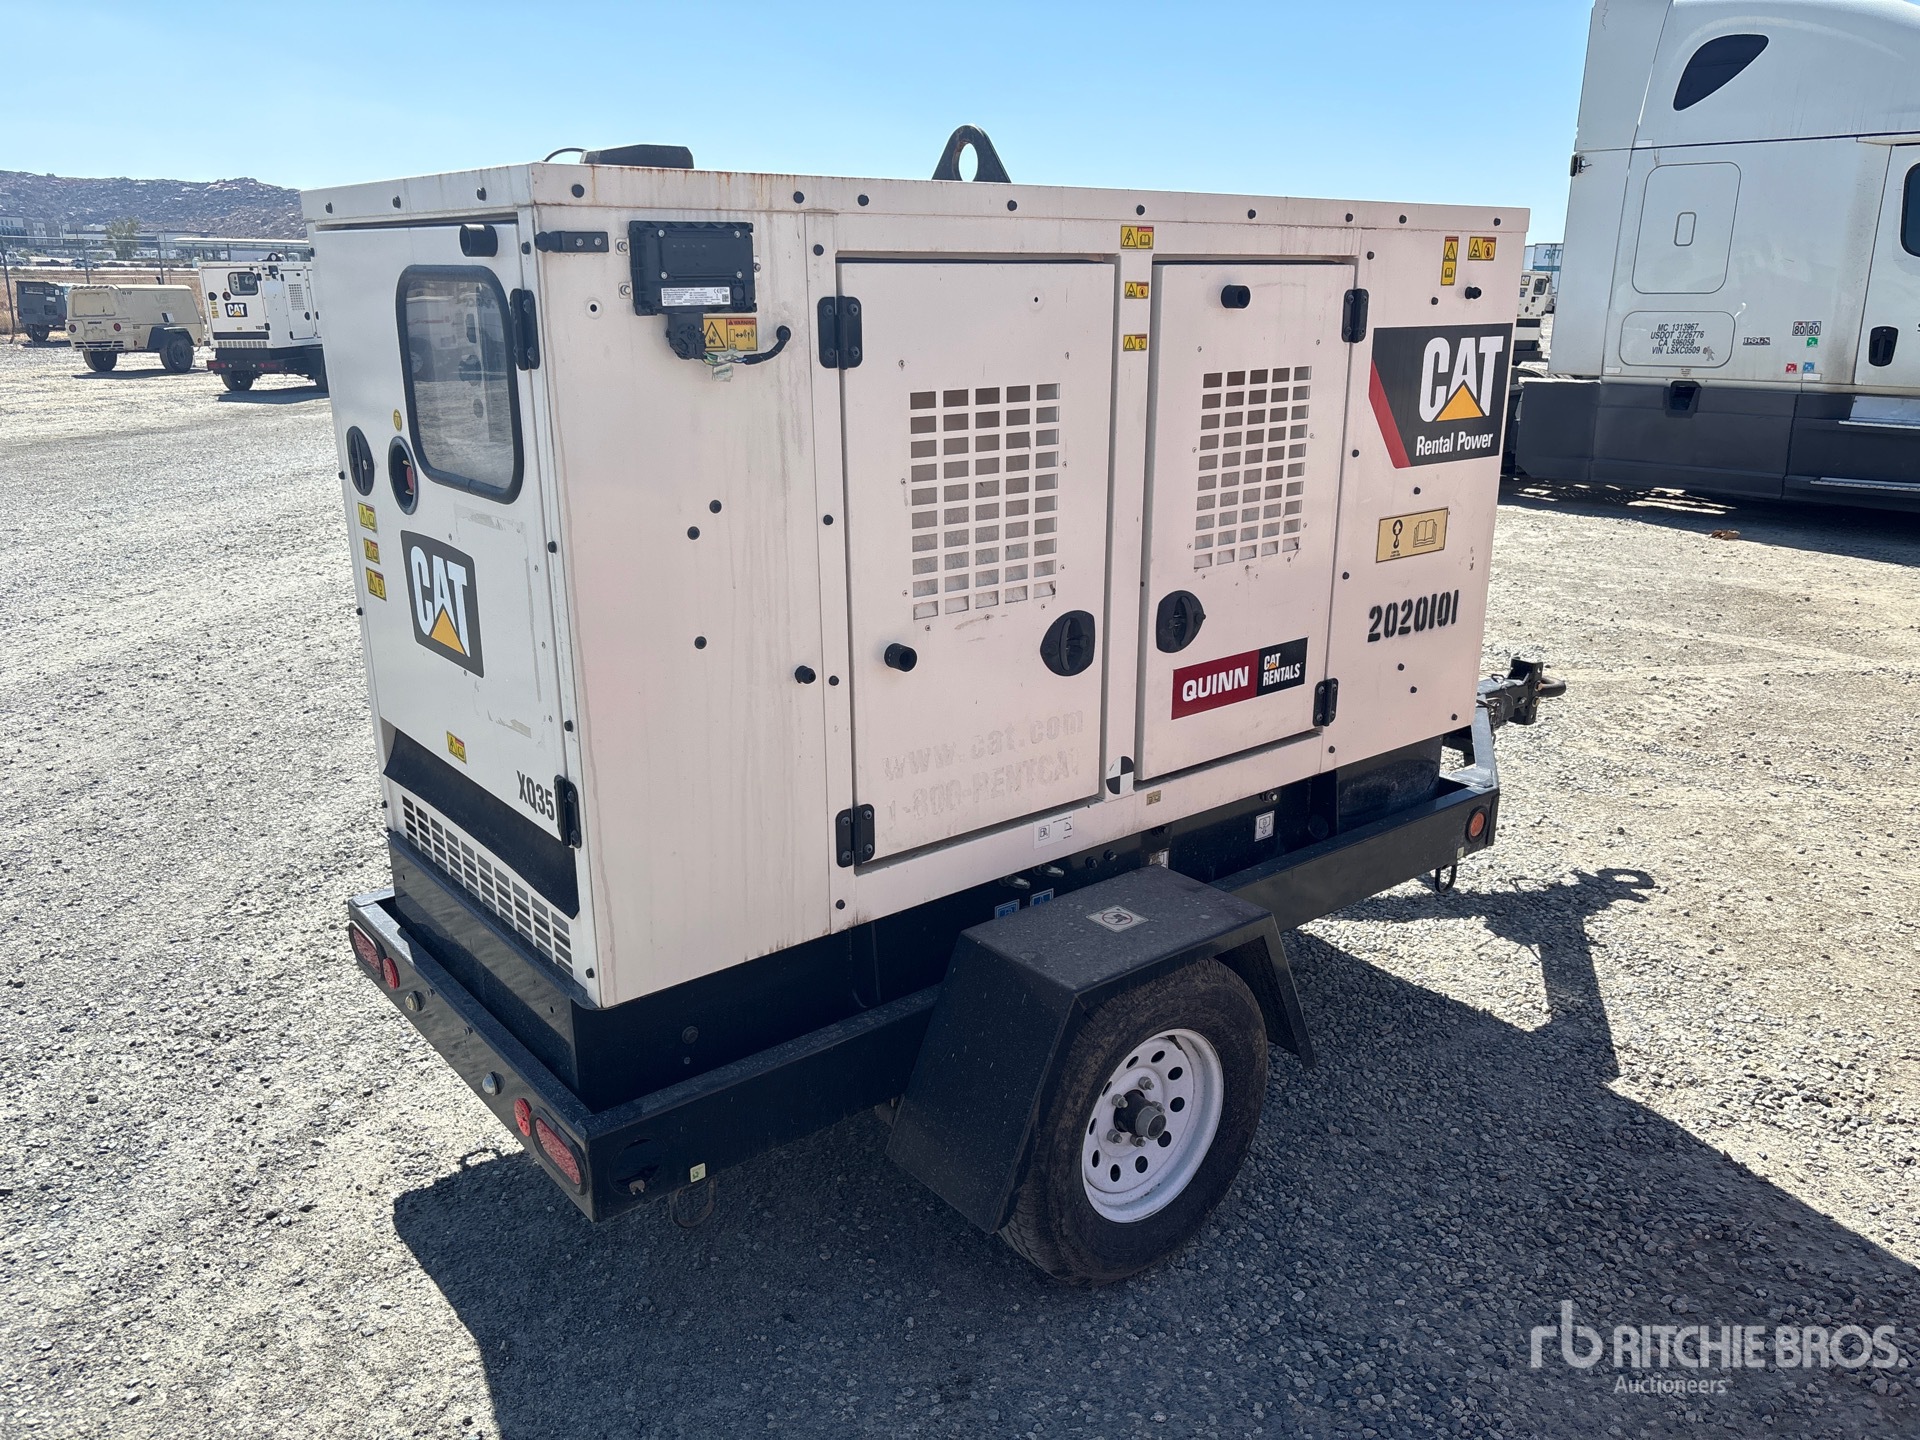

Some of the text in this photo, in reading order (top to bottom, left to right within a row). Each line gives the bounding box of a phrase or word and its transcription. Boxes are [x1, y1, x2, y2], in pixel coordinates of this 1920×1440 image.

[227, 303, 245, 316] CAT
[1650, 331, 1674, 340] USDOT
[1657, 323, 1669, 332] MC
[1794, 325, 1805, 335] 80
[1808, 325, 1820, 335] 80
[1652, 346, 1663, 354] VIN
[1658, 339, 1668, 347] CA
[1418, 335, 1505, 423] CAT
[1415, 430, 1494, 457] Rental Power
[410, 545, 471, 658] CAT
[1263, 652, 1281, 671] CAT
[1262, 662, 1300, 687] RENTALS
[1182, 665, 1249, 702] QUINN
[516, 769, 555, 821] XQ35
